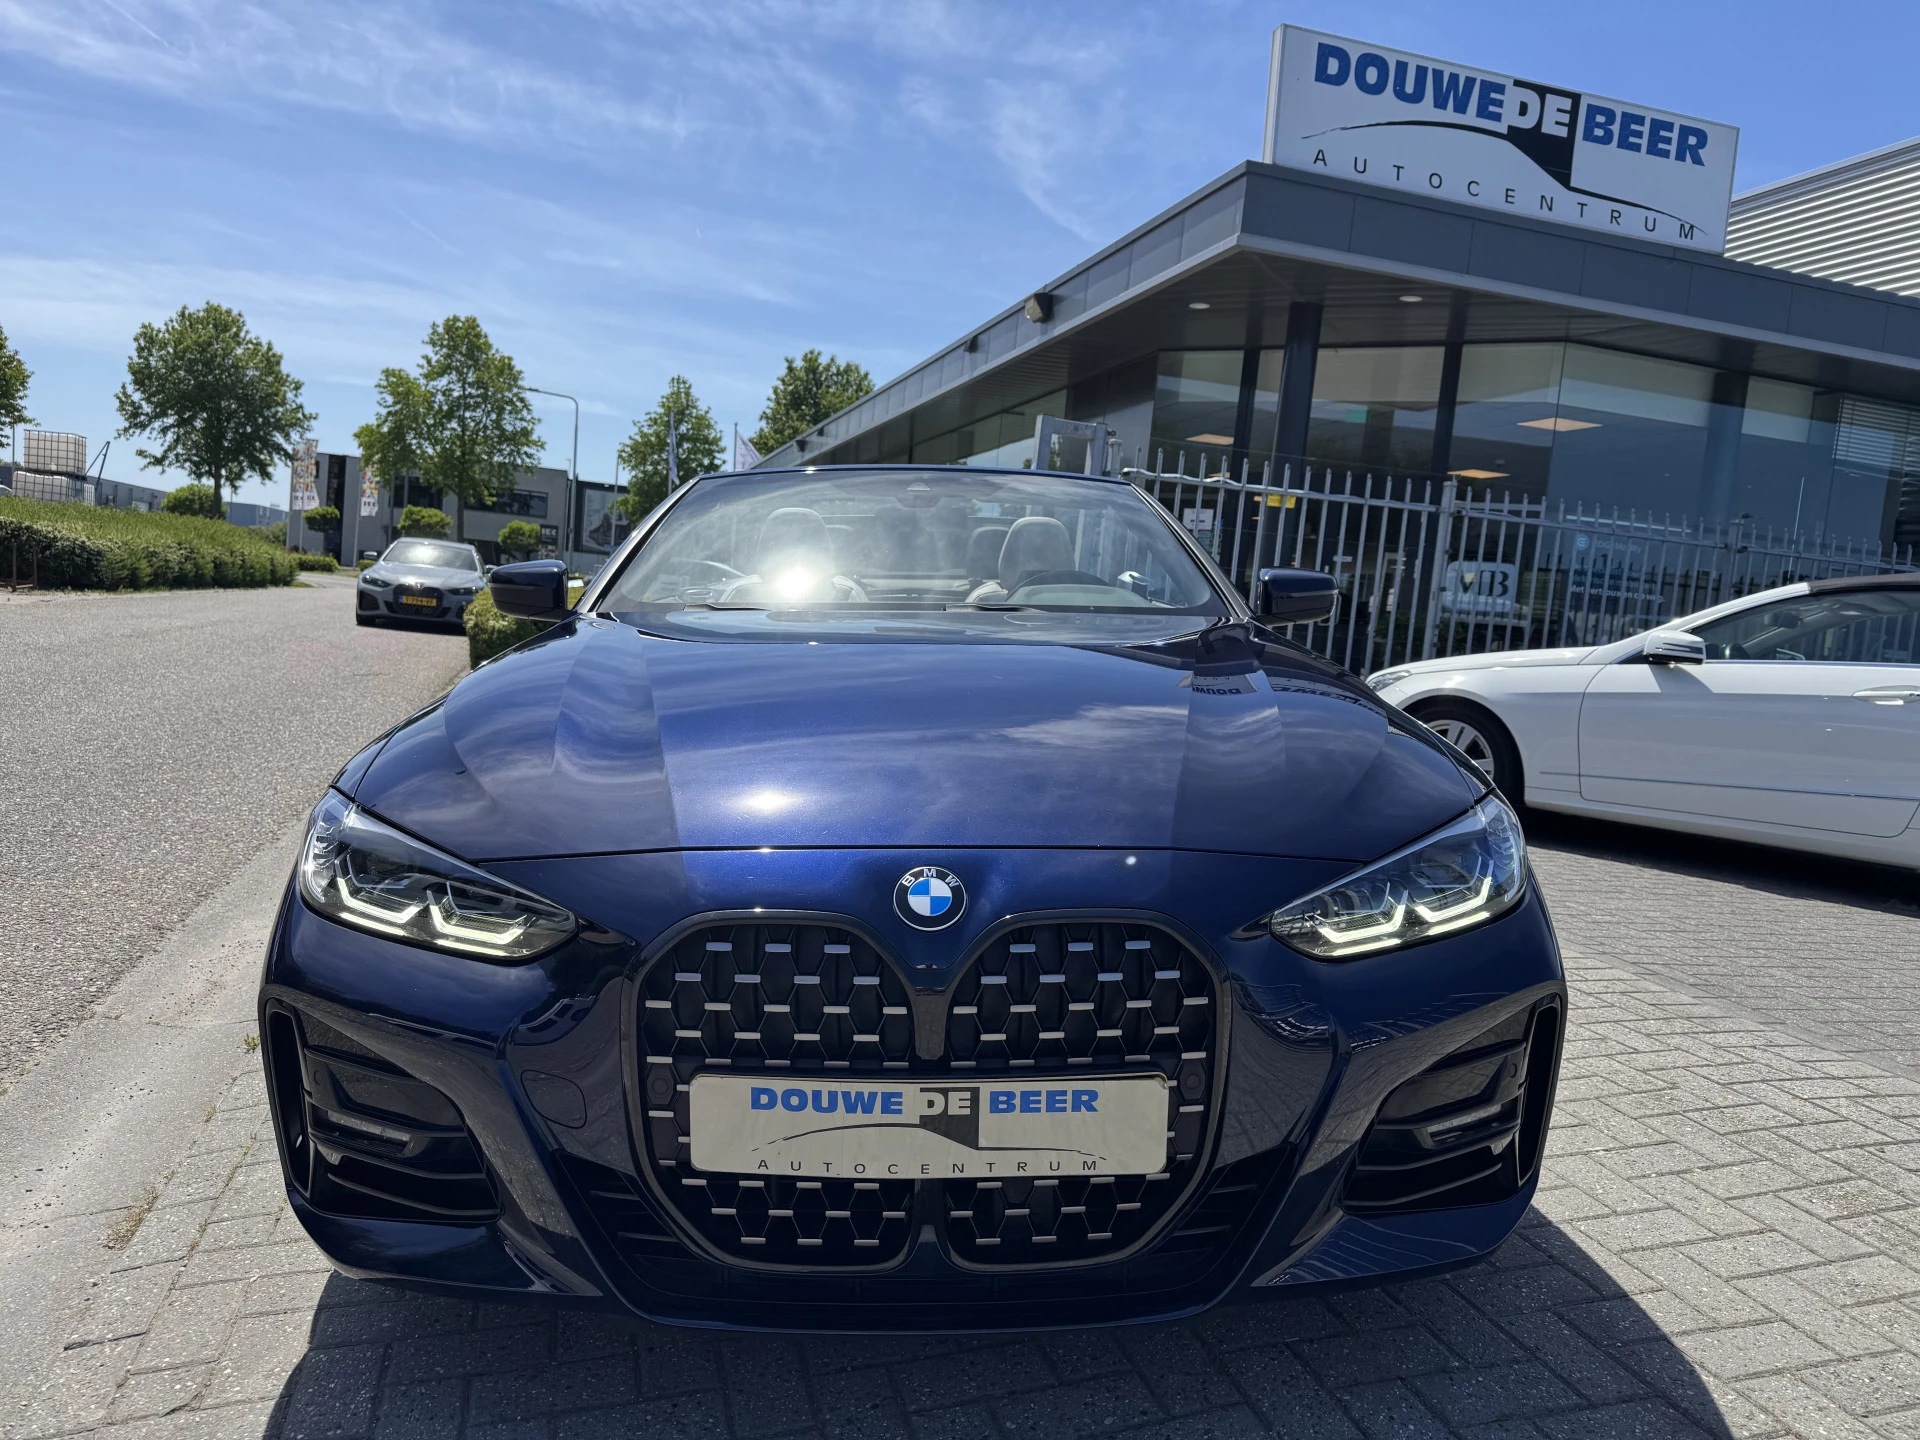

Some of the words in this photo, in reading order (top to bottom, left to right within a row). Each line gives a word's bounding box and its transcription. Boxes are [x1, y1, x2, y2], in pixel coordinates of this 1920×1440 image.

[1314, 42, 1507, 123] DOUWE
[1507, 84, 1573, 138] DE
[1582, 103, 1709, 167] BEER
[1313, 149, 1694, 241] AUTOCENTRUM
[901, 868, 960, 887] BMW
[750, 1087, 904, 1115] DOUWE
[918, 1091, 972, 1116] DE
[989, 1089, 1099, 1114] BEER
[757, 1159, 1097, 1174] AUTOCENTRUM
